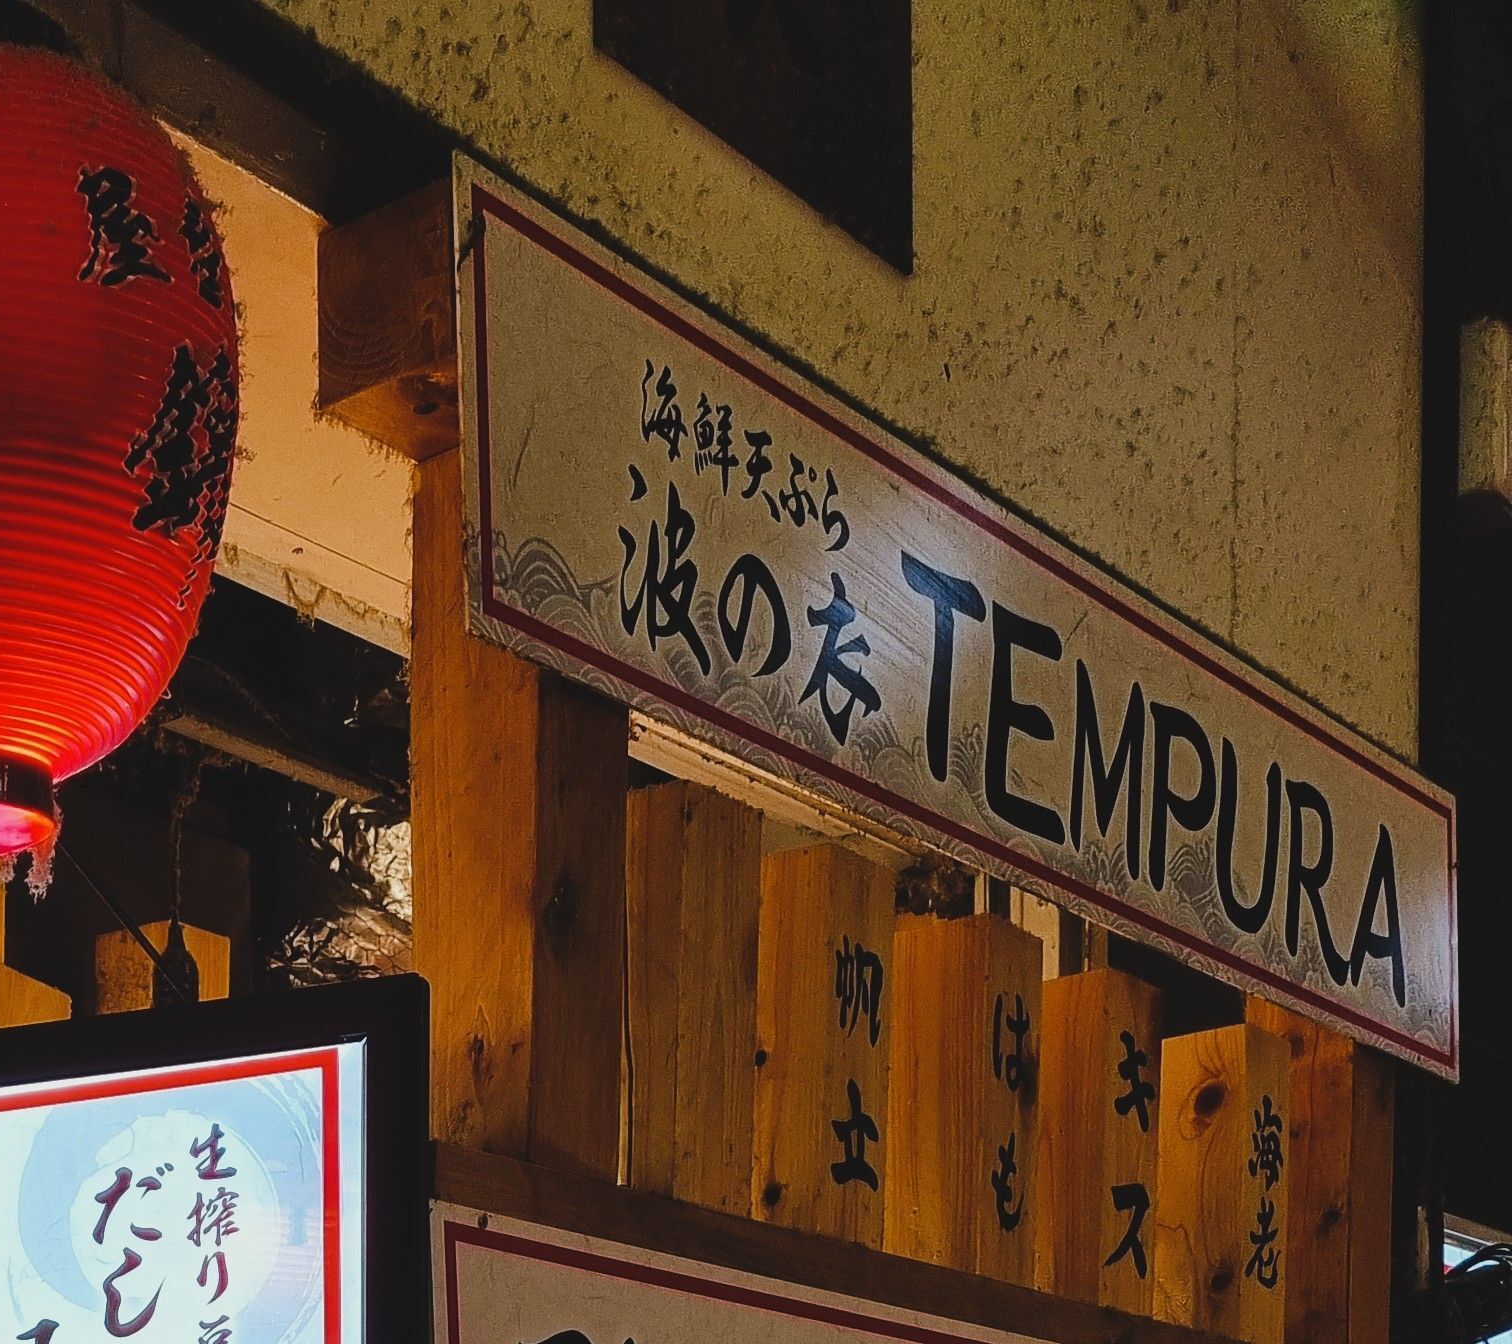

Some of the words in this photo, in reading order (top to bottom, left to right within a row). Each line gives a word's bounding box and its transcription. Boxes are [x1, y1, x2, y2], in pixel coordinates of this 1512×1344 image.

[641, 359, 849, 553] 海鮮天ぷら
[900, 549, 1407, 1008] TEMPURA
[831, 934, 884, 1193] 帆立
[992, 991, 1031, 1232] はも
[1103, 1030, 1156, 1280] キス
[1244, 1095, 1285, 1290] 海老
